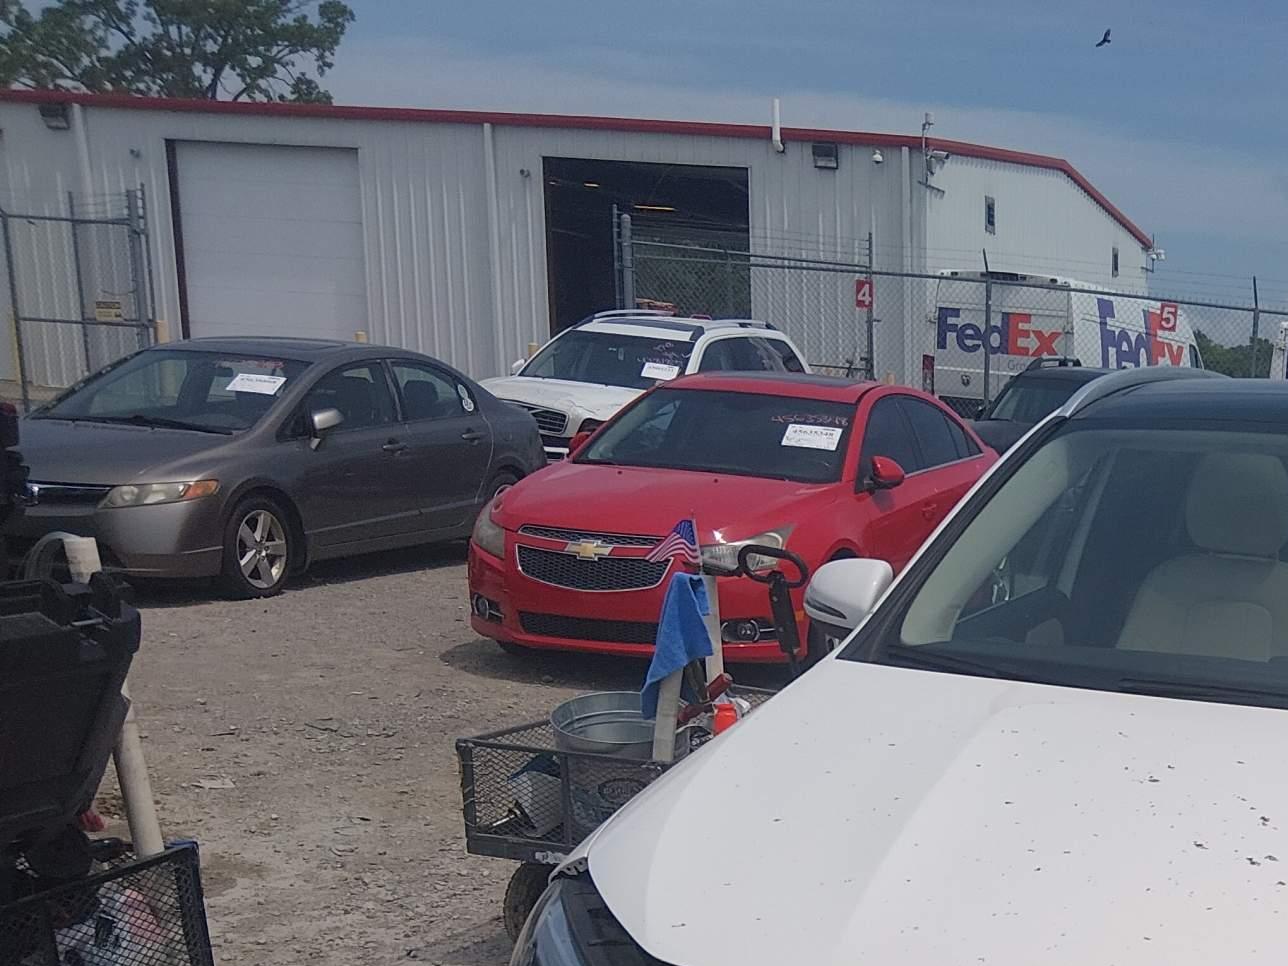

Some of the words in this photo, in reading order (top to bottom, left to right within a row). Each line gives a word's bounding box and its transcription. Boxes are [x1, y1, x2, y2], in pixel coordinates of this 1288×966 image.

[857, 284, 871, 305] 4
[1161, 307, 1175, 328] 5
[937, 307, 1063, 357] FedEx
